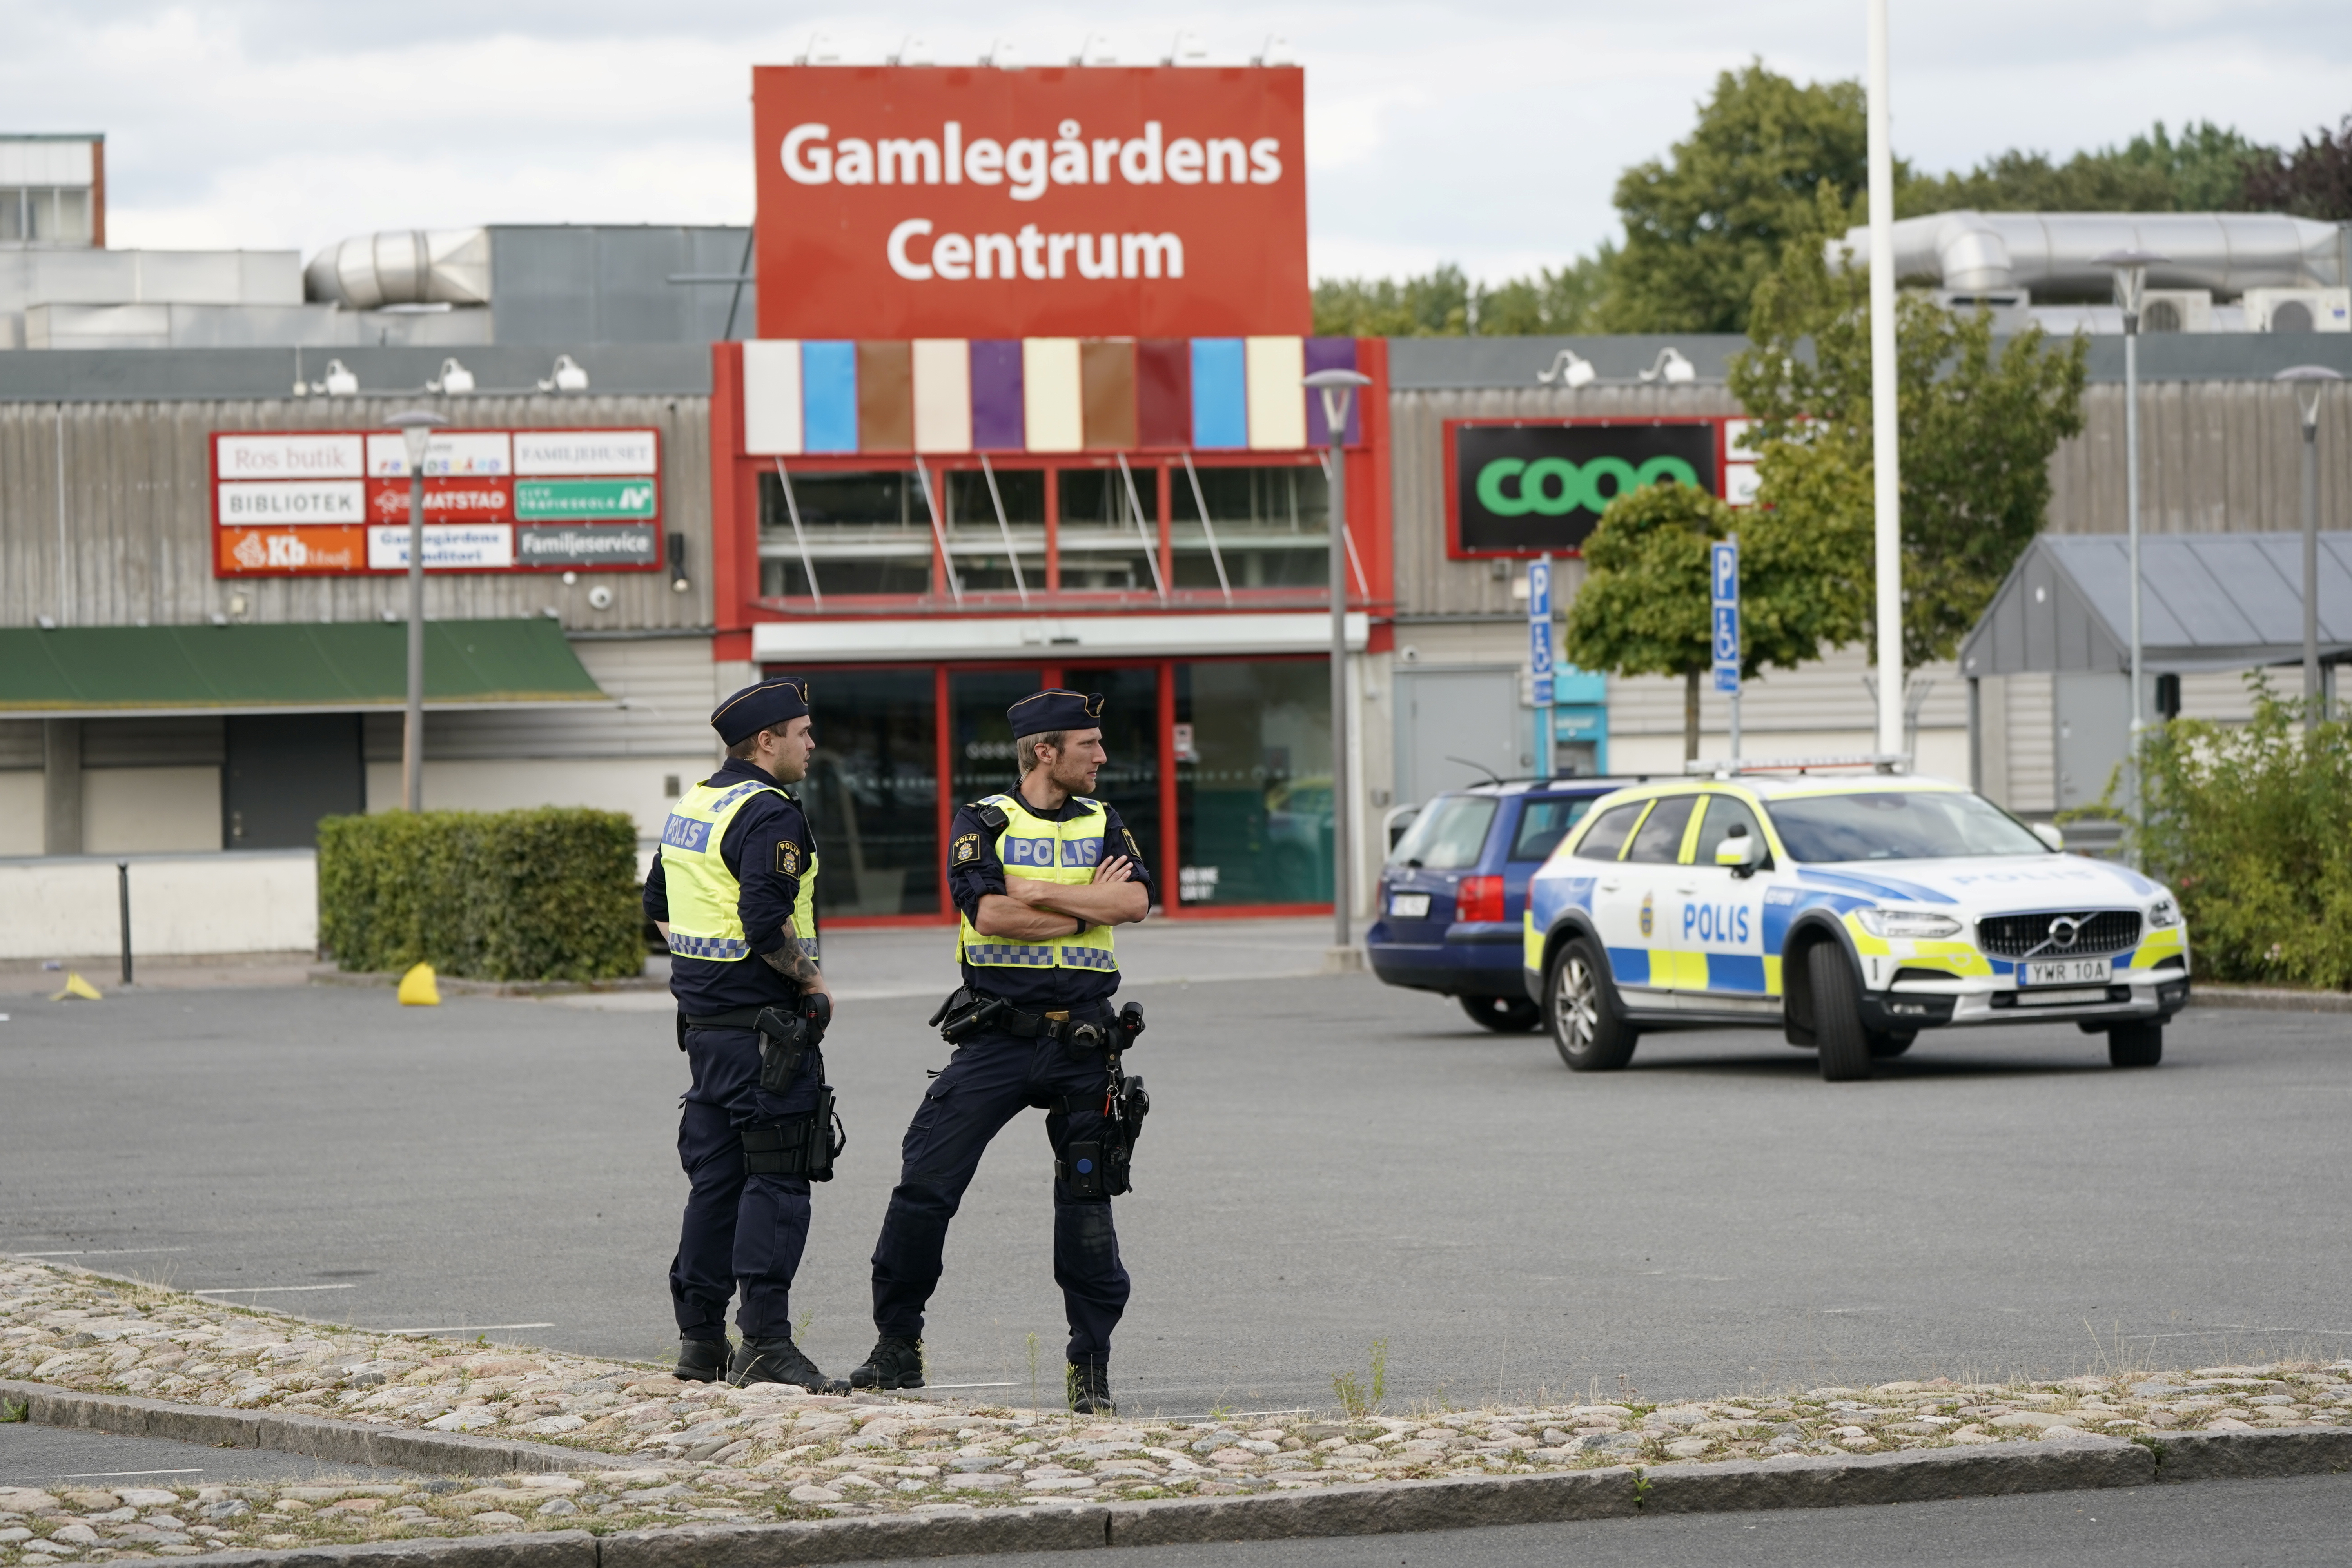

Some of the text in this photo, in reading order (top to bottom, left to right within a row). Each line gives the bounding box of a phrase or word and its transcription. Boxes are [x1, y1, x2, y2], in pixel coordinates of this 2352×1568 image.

[780, 119, 1283, 201] Gamlegårdens
[887, 218, 1184, 280] Centrum
[235, 445, 346, 470] Ros butik
[521, 446, 646, 463] FAMILJEHUSET
[230, 494, 352, 512] BIBLIOTEK
[267, 535, 307, 567] Kb
[399, 550, 481, 562] Knditori
[522, 531, 648, 558] Familjeservice
[1717, 550, 1732, 597] P
[1533, 568, 1547, 613] P
[665, 816, 703, 848] POLIS
[955, 835, 977, 847] POLIS
[779, 842, 799, 856] POLIS
[1014, 839, 1097, 866] POLIS
[1952, 871, 2095, 884] POLIS
[1684, 904, 1749, 944] POLIS
[2033, 963, 2104, 981] YWR 10A
